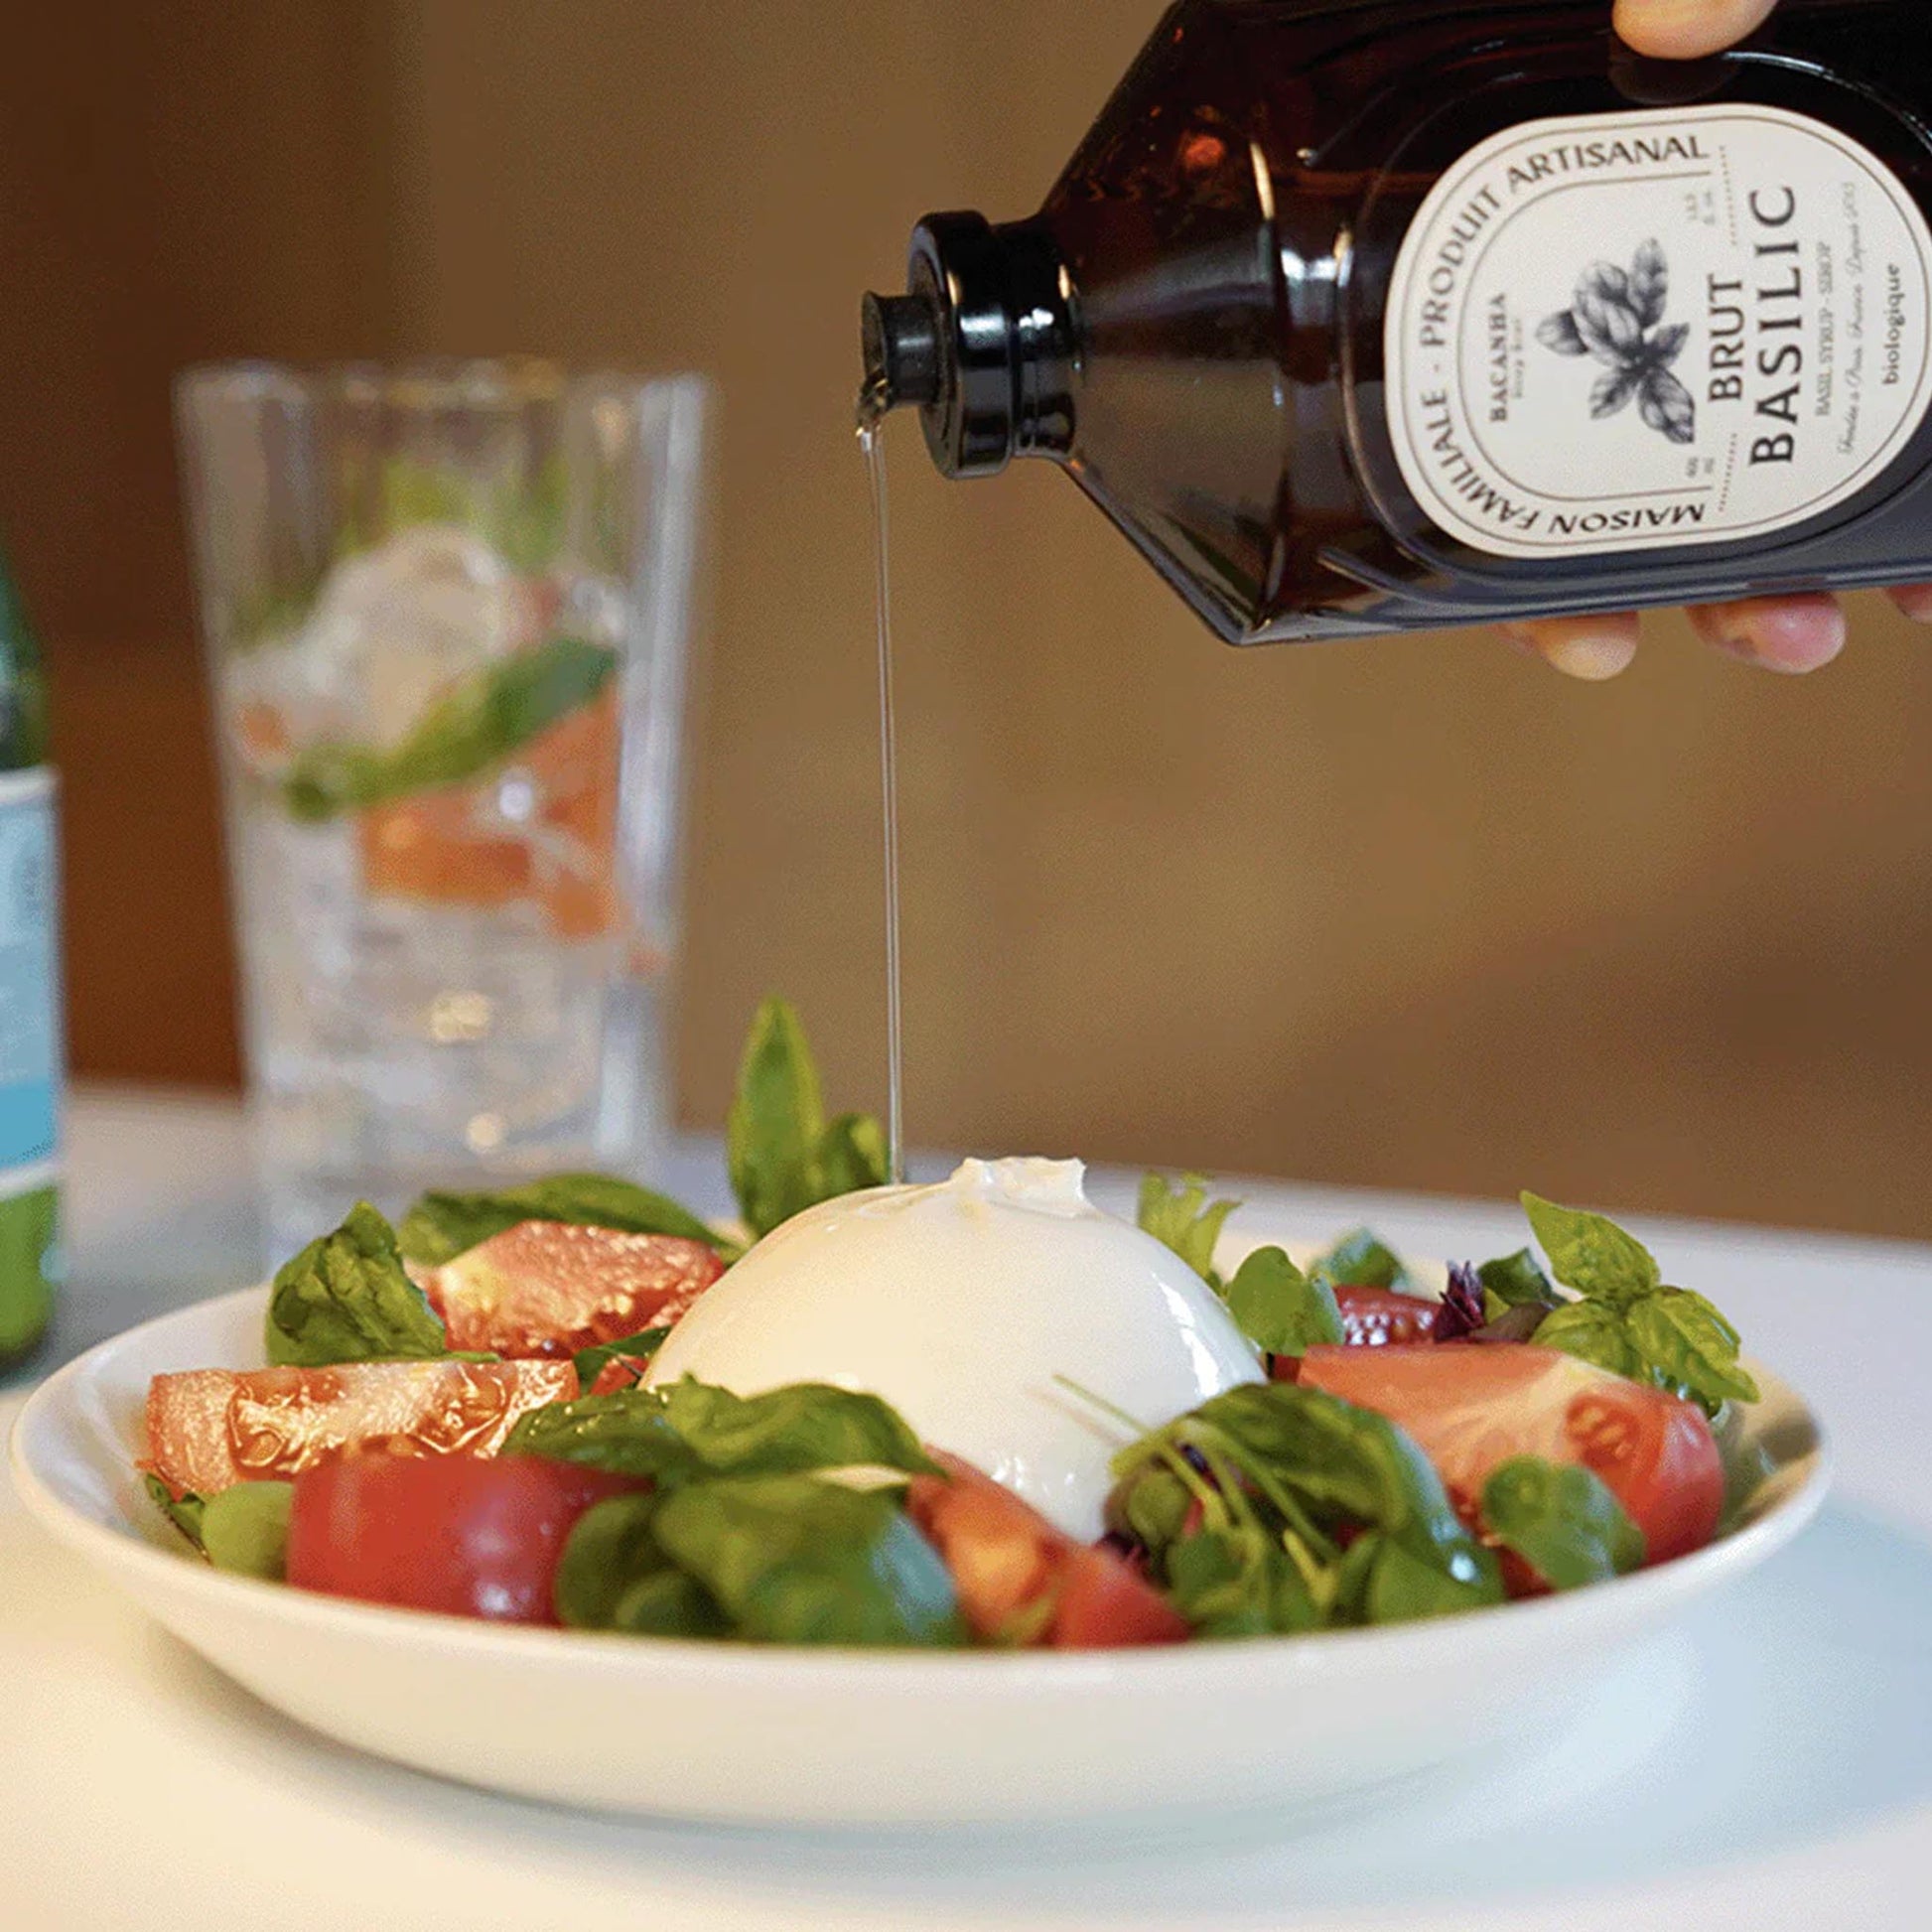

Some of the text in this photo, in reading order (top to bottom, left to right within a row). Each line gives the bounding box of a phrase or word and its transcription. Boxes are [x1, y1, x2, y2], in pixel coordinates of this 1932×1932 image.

[1505, 135, 1710, 194] ARTISANAL
[1419, 183, 1501, 346] PRODUIT
[1749, 186, 1803, 466] BASILIC
[1881, 264, 1905, 385] biologique
[1488, 293, 1507, 422] BACANHA
[1707, 272, 1745, 402] BRUT
[1815, 366, 1833, 417] BASIL
[1420, 388, 1542, 531] FAMILIALE
[1548, 501, 1706, 535] MAISON
